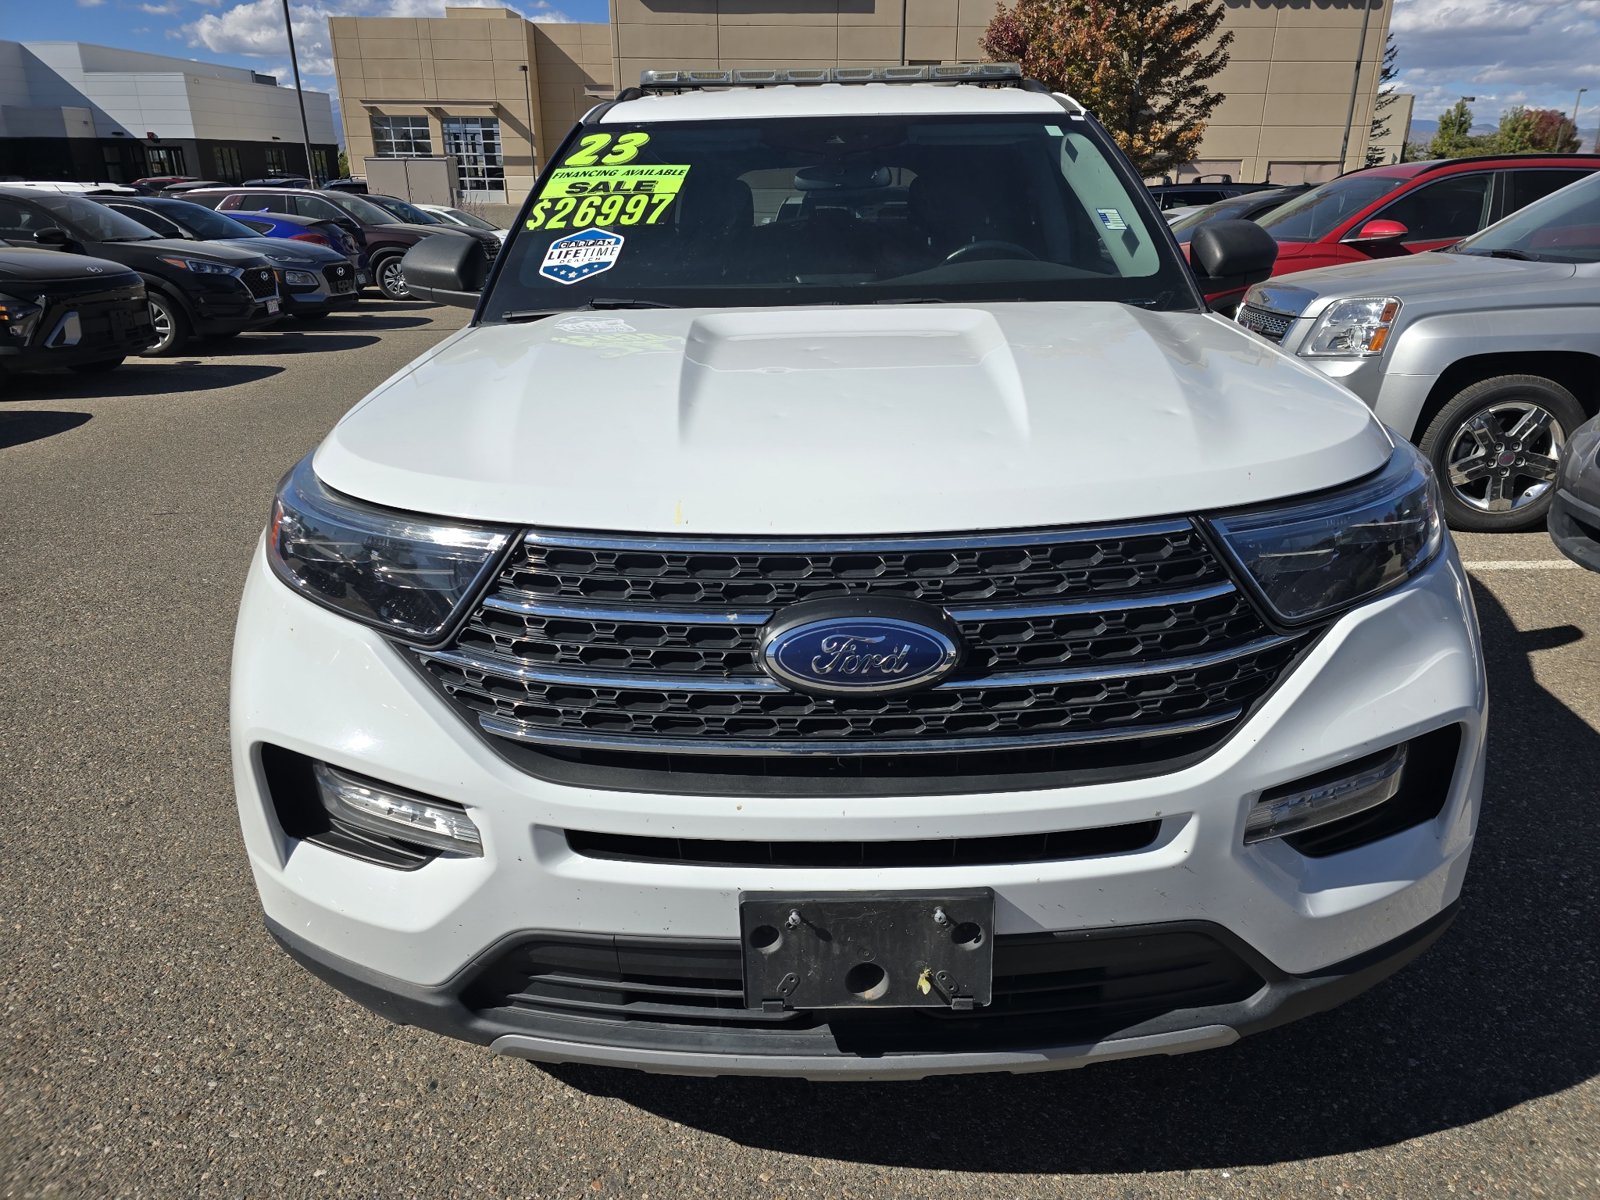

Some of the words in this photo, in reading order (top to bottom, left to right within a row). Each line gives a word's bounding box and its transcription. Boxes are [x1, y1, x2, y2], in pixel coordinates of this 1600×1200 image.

[564, 132, 651, 167] 23
[551, 168, 619, 180] FINANCING
[621, 168, 687, 177] AVAILABLE
[565, 180, 658, 195] SALE
[526, 193, 676, 231] $26997
[559, 239, 614, 249] CARFAX
[548, 246, 619, 260] LIFETIME
[811, 634, 911, 674] Ford
